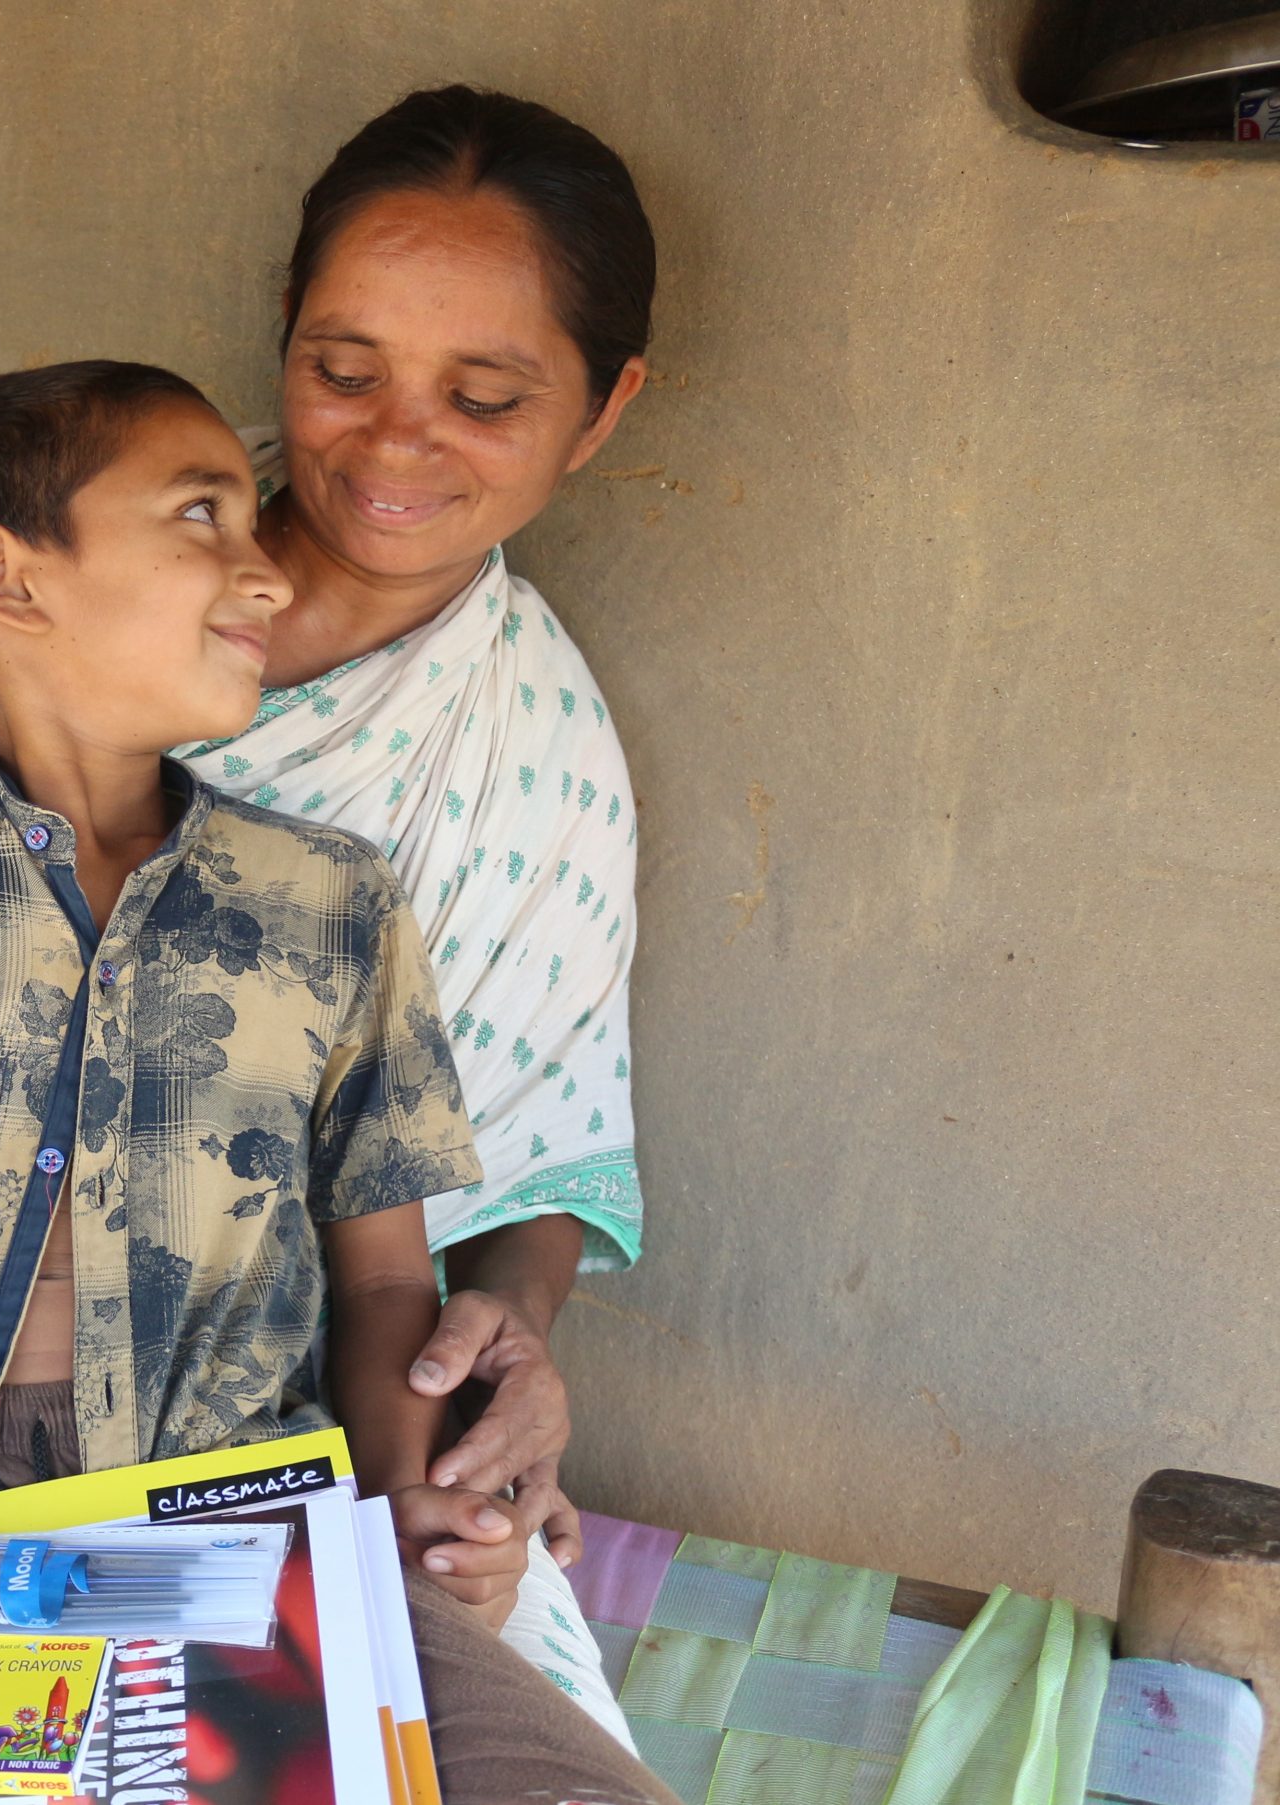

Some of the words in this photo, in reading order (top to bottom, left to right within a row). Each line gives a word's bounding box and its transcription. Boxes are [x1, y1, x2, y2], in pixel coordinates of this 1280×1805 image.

[8, 1547, 37, 1591] Moon
[8, 1660, 83, 1672] CRAYONS
[8, 1760, 29, 1769] NON
[31, 1761, 60, 1770] TOXIC
